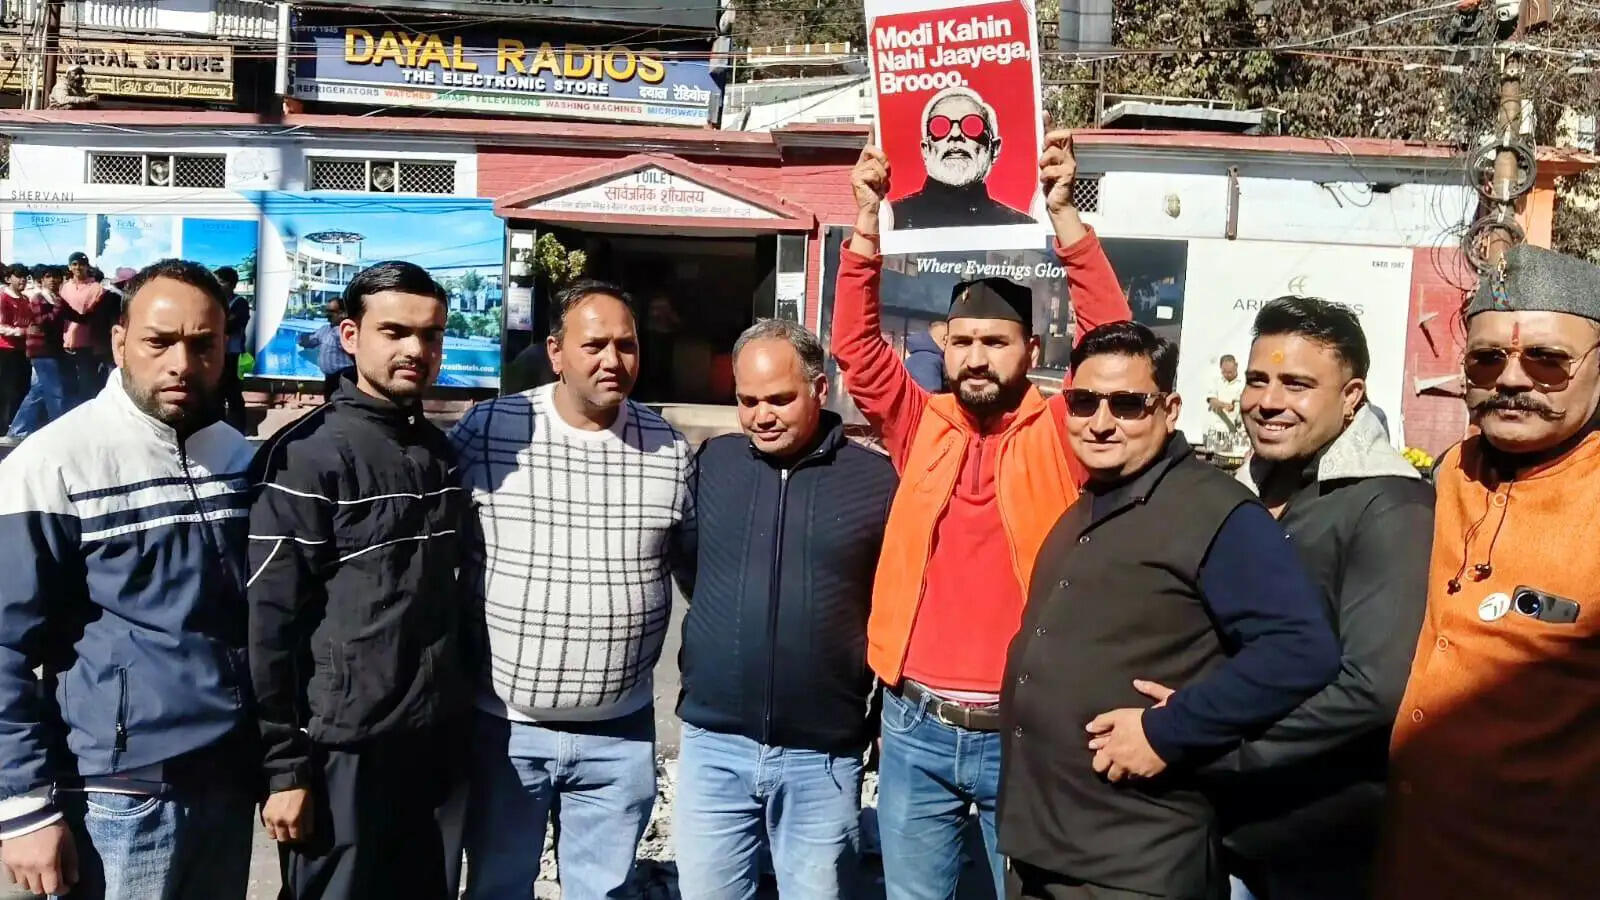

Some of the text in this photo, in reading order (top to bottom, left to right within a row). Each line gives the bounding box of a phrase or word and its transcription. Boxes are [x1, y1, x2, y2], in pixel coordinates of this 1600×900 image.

[875, 15, 1012, 49] Modi Kahin
[144, 50, 225, 73] STORE
[344, 28, 666, 84] DAYAL RADIOS
[878, 41, 1031, 72] Nahi Jaayega,
[402, 69, 609, 96] THE ELECTRONIC STORE
[879, 70, 969, 95] Broooo.
[296, 84, 380, 97] REFRIGERATORS
[474, 95, 541, 107] TELEVISIONS
[545, 101, 590, 110] WASHING
[592, 103, 643, 114] MACHINES
[635, 171, 673, 185] TOILET
[11, 190, 74, 202] SHERVANI
[917, 257, 962, 274] Where
[965, 260, 1032, 280] Evenings
